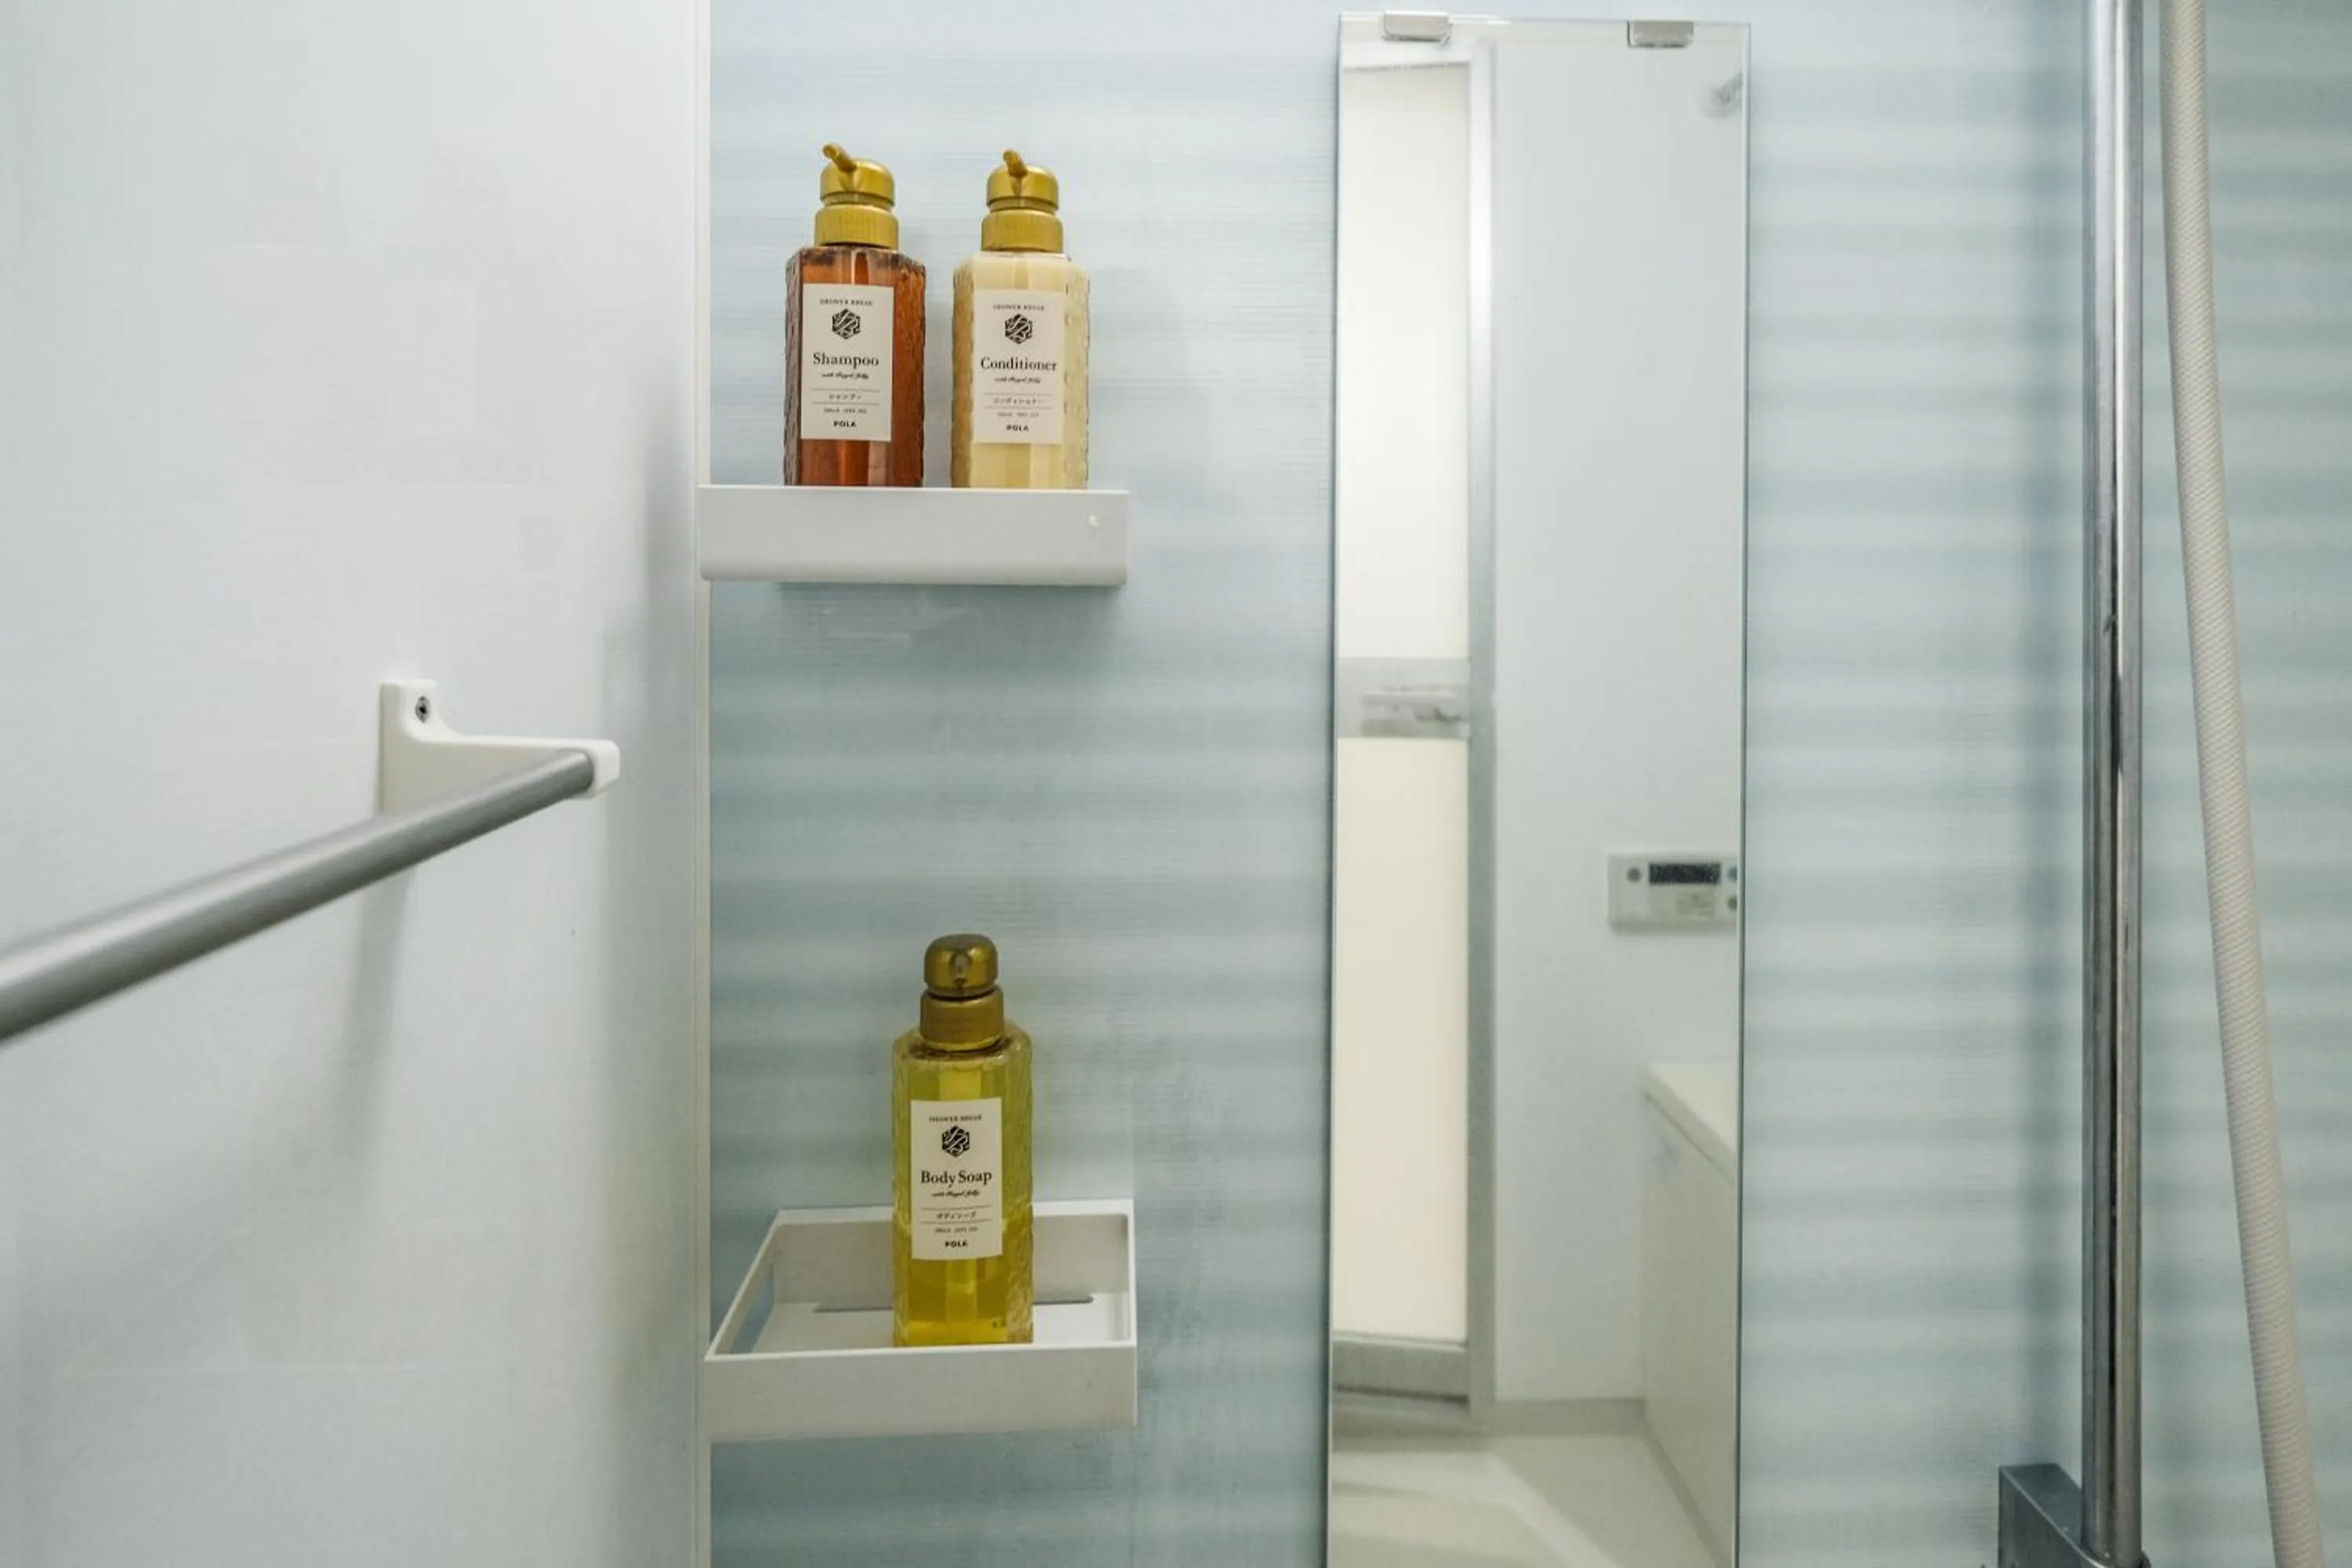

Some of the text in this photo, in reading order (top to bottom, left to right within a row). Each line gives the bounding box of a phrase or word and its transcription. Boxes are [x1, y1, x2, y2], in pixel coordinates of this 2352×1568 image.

[813, 351, 879, 369] Shampoo
[981, 356, 1057, 371] Conditioner
[921, 1170, 993, 1189] Body Soap
